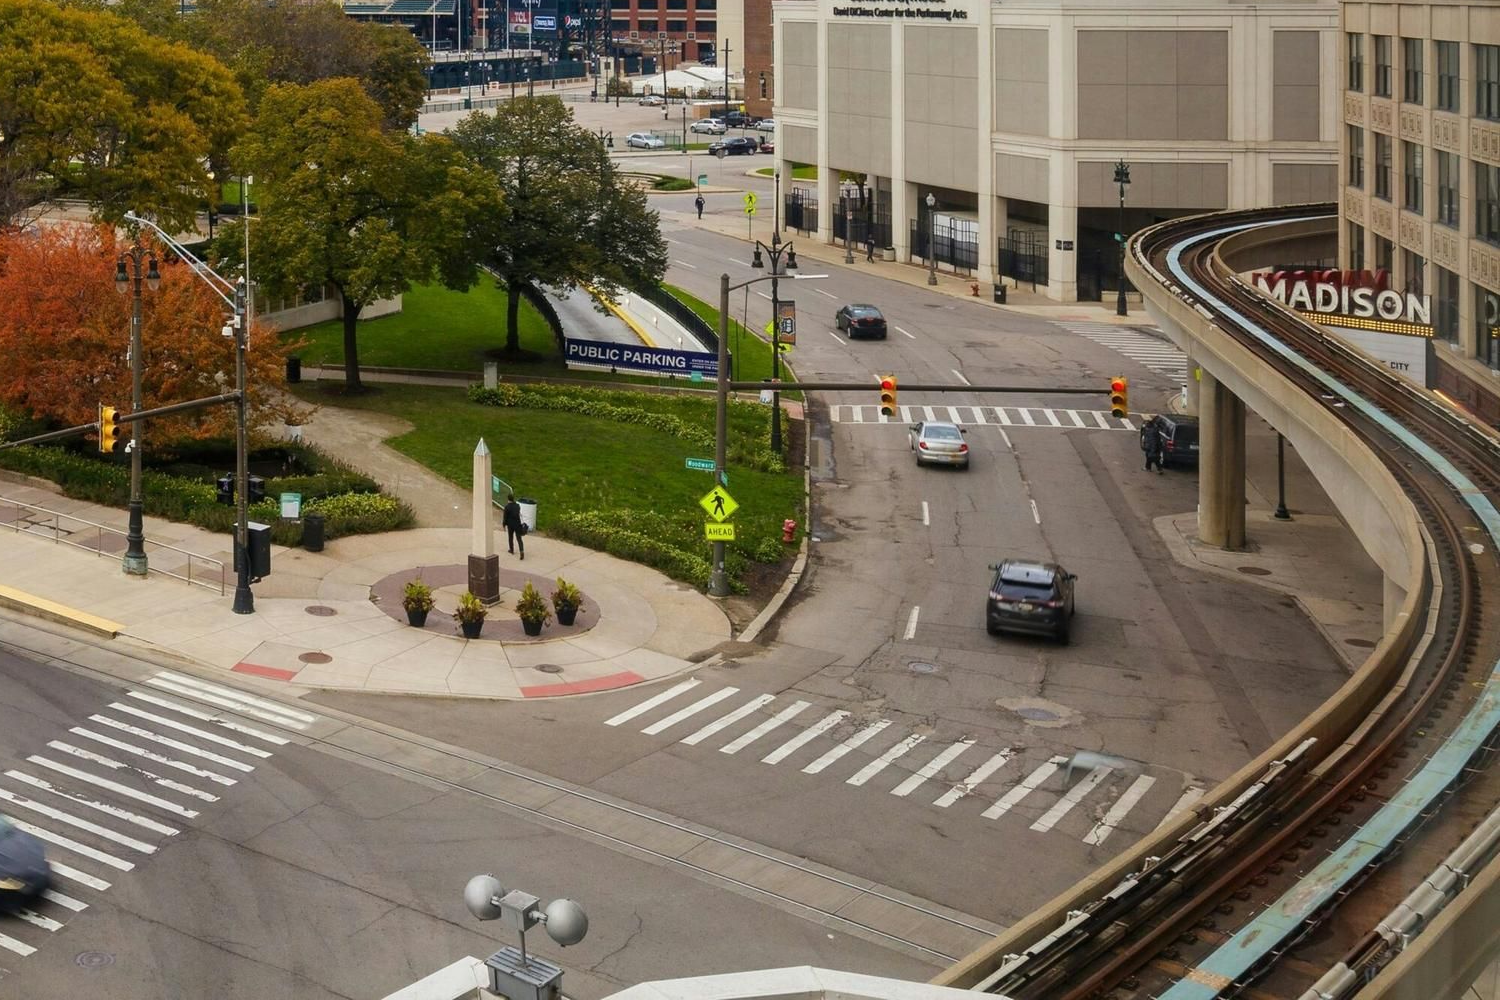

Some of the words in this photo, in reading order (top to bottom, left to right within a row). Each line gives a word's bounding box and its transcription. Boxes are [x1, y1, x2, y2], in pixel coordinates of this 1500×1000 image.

[514, 11, 527, 23] TCL
[874, 7, 894, 17] Center
[895, 7, 904, 17] for
[904, 8, 915, 17] the
[952, 9, 967, 19] Arts
[1257, 276, 1431, 324] MADISON
[569, 344, 620, 361] PUBLIC
[623, 350, 686, 368] PARKING
[1390, 361, 1411, 371] CITY
[708, 526, 732, 536] AHEAD
